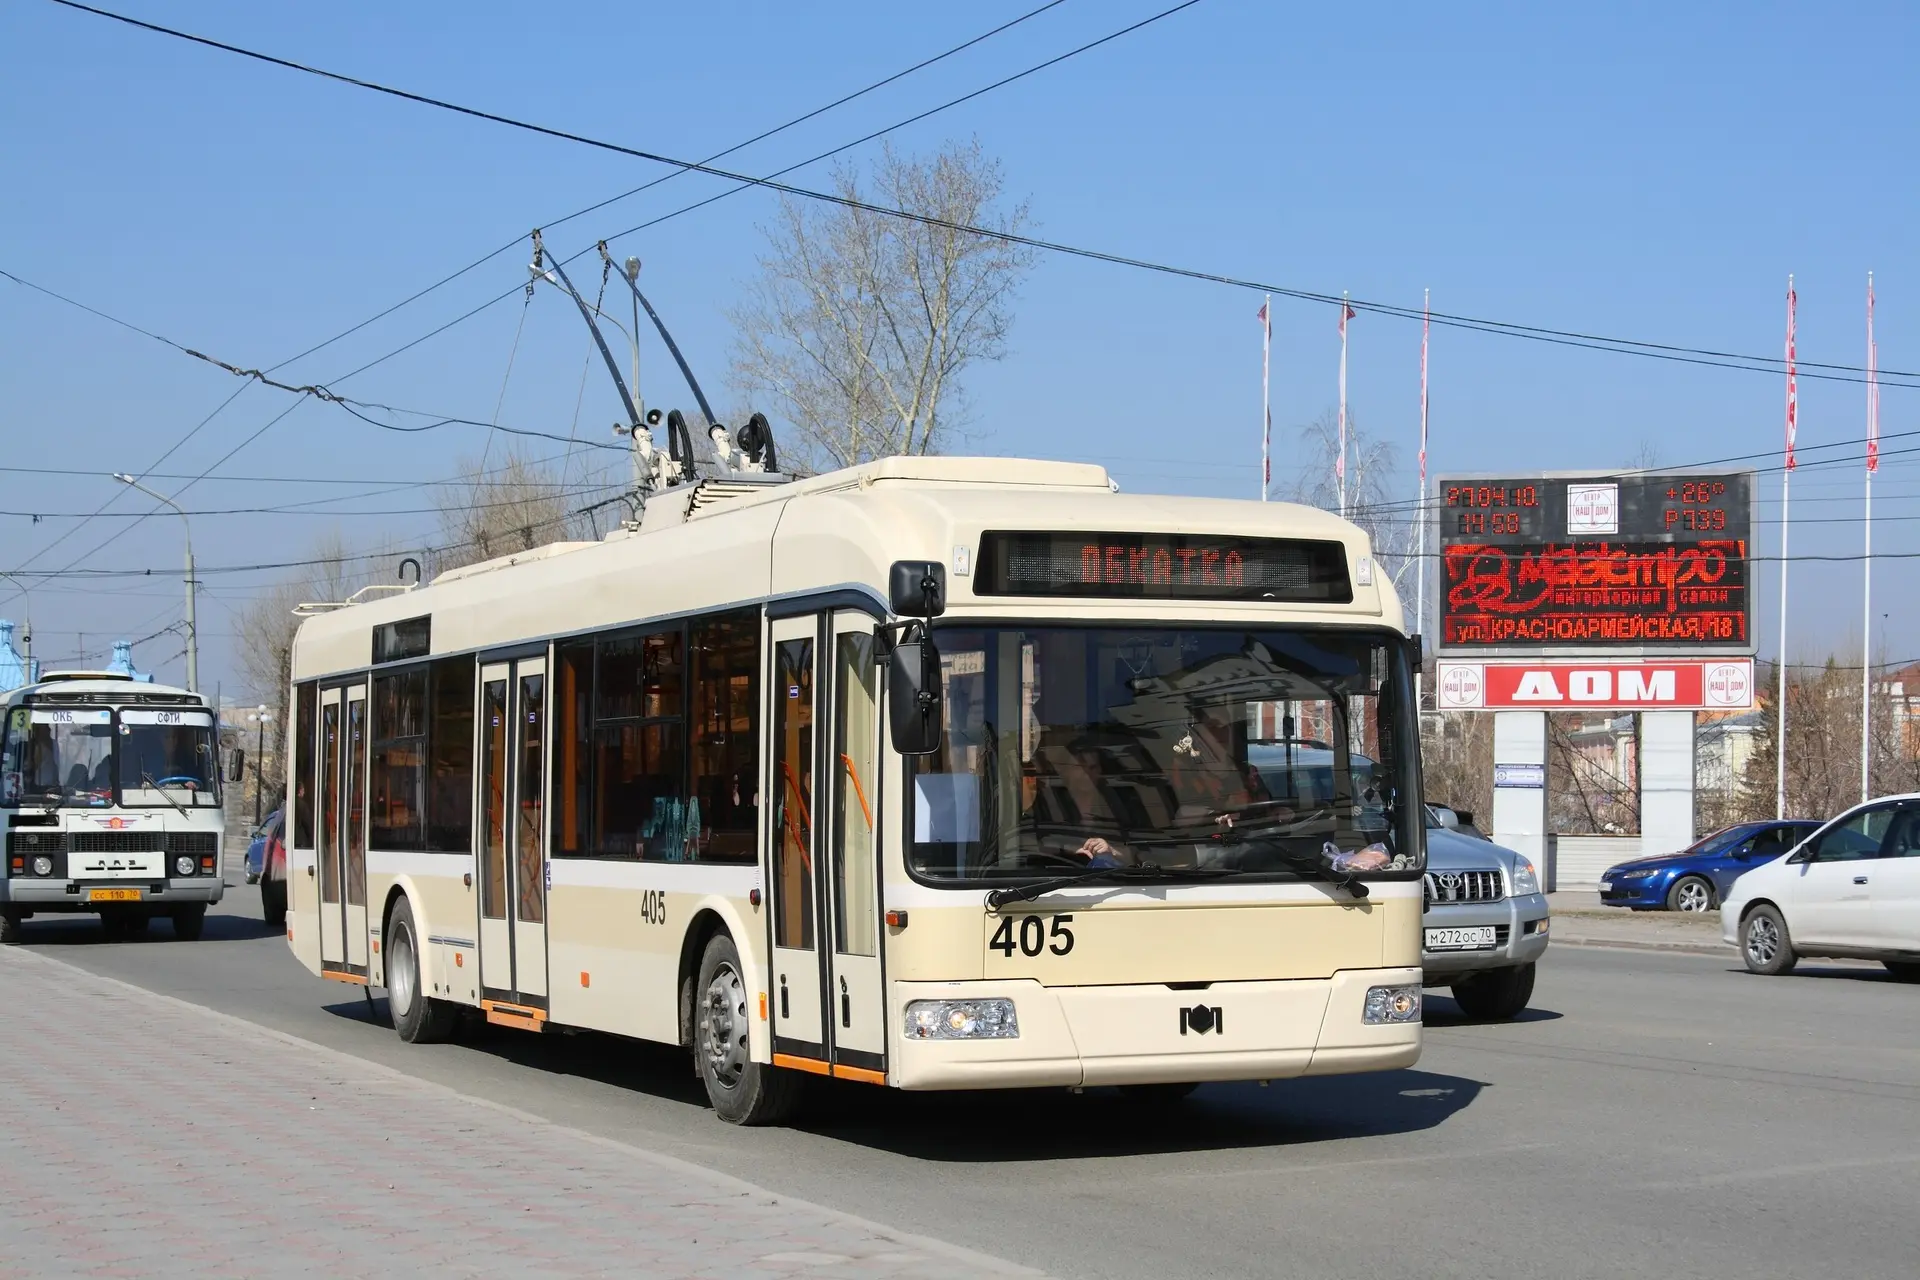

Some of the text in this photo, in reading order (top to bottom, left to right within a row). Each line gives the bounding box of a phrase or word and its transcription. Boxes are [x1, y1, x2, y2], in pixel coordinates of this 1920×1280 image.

[1584, 493, 1600, 502] ЦЕНТР
[1575, 506, 1609, 516] НАШ ДОМ
[1082, 545, 1243, 586] ОБКАТКА
[1709, 617, 1732, 637] 18
[1445, 683, 1477, 692] НАШ ДОМ
[1512, 670, 1676, 700] ДОМ
[1710, 681, 1744, 690] НАШ ДОМ
[17, 712, 25, 727] 3
[52, 712, 72, 722] ОКБ
[157, 712, 181, 723] СФТИ
[641, 889, 666, 925] 405
[989, 914, 1075, 957] 405
[1480, 928, 1491, 938] 70
